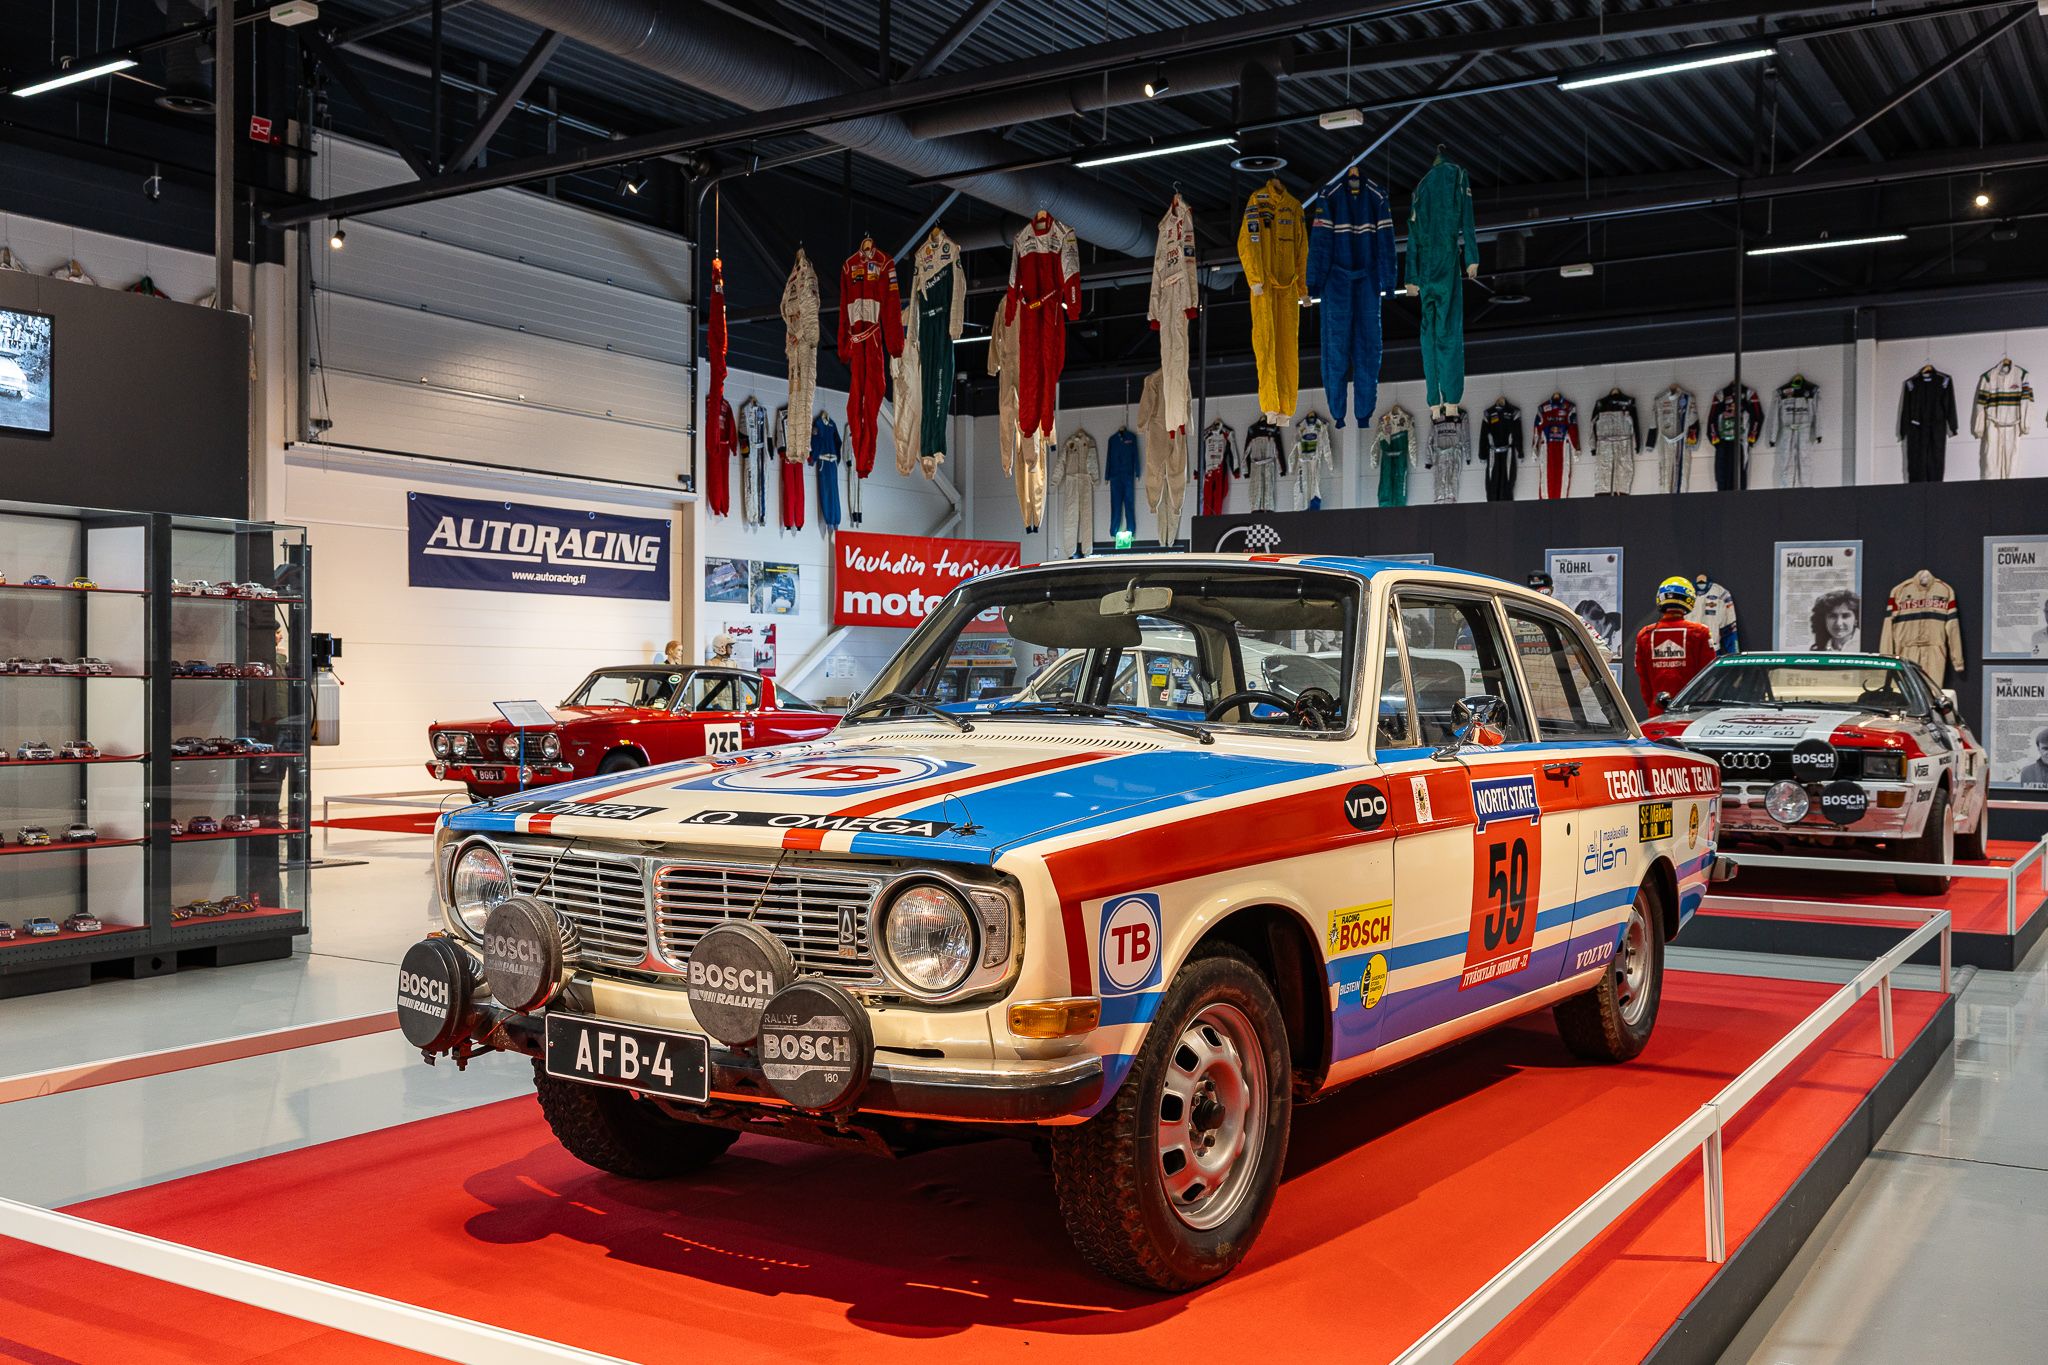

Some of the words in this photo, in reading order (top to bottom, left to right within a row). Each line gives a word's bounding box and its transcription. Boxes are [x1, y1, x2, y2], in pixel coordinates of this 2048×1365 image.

[427, 516, 661, 564] AUTORACING
[845, 545, 926, 576] Vauhdin
[1559, 560, 1593, 574] RÖHRL
[1787, 556, 1834, 568] MOUTON
[1998, 552, 2036, 565] COWAN
[512, 571, 586, 584] www.autoracing.fi
[1828, 658, 1896, 667] MICHELIN
[1996, 682, 2045, 697] MÄKINEN
[1792, 753, 1834, 763] BOSCH
[761, 764, 902, 782] TB
[1604, 769, 1652, 800] TEBOIL
[1652, 767, 1691, 796] RACING
[1691, 767, 1715, 791] TEAM
[1345, 796, 1387, 819] VDO
[1476, 788, 1510, 814] NORTH
[1508, 785, 1536, 810] STATE
[1822, 795, 1865, 806] BOSCH
[538, 801, 652, 820] OMEGA
[768, 815, 933, 836] OMEGA
[1483, 837, 1529, 951] 59
[1342, 913, 1360, 924] RACING
[1340, 915, 1391, 951] BOSCH
[484, 933, 543, 963] BOSCH
[1112, 922, 1151, 966] TB
[1576, 941, 1613, 970] VOLVO
[400, 970, 449, 1005] BOSCH
[690, 961, 774, 996] BOSCH
[1340, 981, 1361, 996] BILSTEIN
[413, 1000, 442, 1018] RALLYE
[716, 992, 764, 1010] RALLYE
[764, 1014, 798, 1025] RALLYE
[763, 1034, 851, 1062] BOSCH
[575, 1029, 674, 1087] AFB-4
[824, 1073, 839, 1083] 180
